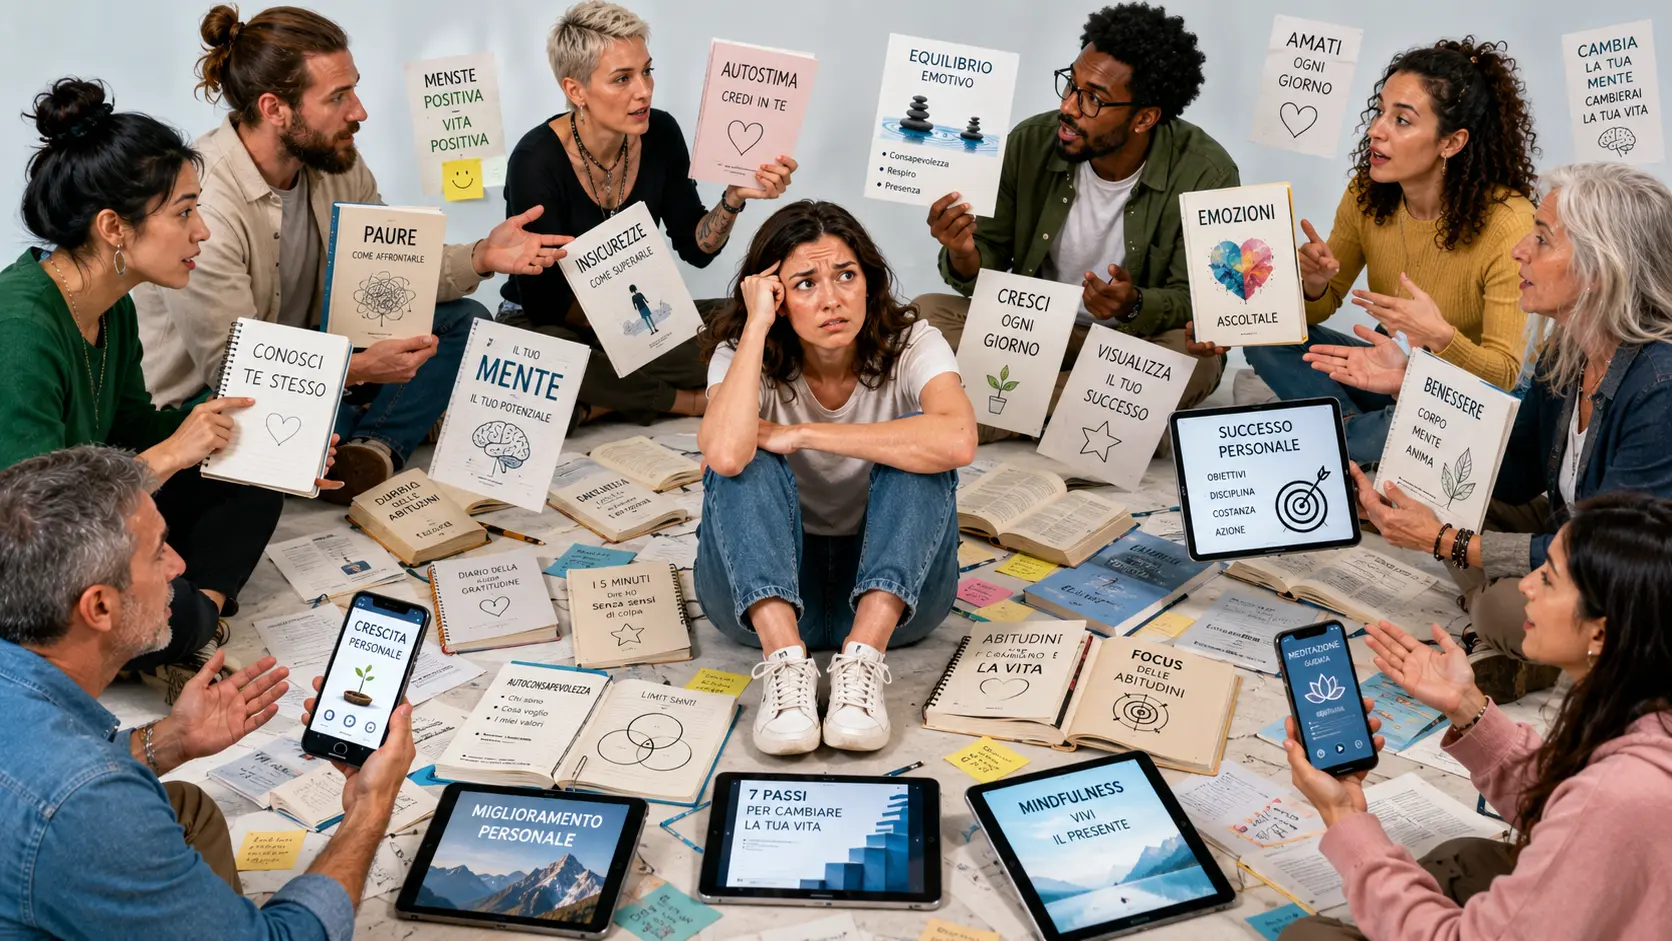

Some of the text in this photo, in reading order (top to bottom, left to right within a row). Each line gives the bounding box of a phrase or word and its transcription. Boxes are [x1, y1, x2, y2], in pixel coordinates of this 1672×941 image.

[1286, 32, 1342, 56] AMATI
[1578, 36, 1639, 58] CAMBIA
[909, 49, 993, 75] EQUILIBRIO
[1294, 57, 1326, 73] OGNI
[1586, 56, 1632, 73] LA TUA
[424, 68, 476, 88] MENSTE
[721, 61, 799, 89] AUTOSTIMA
[921, 71, 974, 88] EMOTIVO
[1278, 74, 1332, 95] GIORNO
[1587, 72, 1634, 89] MENTE
[424, 88, 484, 109] POSITIVA
[721, 90, 787, 111] CREDI IN TE
[1585, 89, 1642, 107] CAMBIERAI
[443, 116, 472, 131] VITA
[1583, 104, 1648, 124] LA TUA VITA
[431, 132, 489, 153] POSITIVA
[889, 151, 950, 168] Consapevolezza
[887, 166, 917, 179] Respiro
[885, 181, 921, 195] Presenza
[1198, 204, 1276, 226] EMOZIONI
[364, 225, 418, 246] PAURE
[352, 250, 425, 264] COME AFFRONTARLE
[575, 222, 647, 273] INSICUREZZE
[590, 245, 654, 289] COME SUPERARLE
[997, 288, 1051, 312] CRESCI
[1001, 314, 1034, 332] OGNI
[1217, 311, 1278, 327] ASCOLTALE
[513, 345, 541, 360] IL TUO
[984, 333, 1040, 357] GIORNO
[253, 342, 324, 369] CONOSCI
[1098, 344, 1172, 381] VISUALIZZA
[244, 368, 327, 397] TE STESSO
[476, 355, 564, 400] MENTE
[1106, 373, 1143, 394] IL TUO
[1084, 388, 1149, 421] SUCCESSO
[1424, 376, 1485, 420] BENESSERE
[470, 394, 552, 423] IL TUO POTENZIALE
[1418, 407, 1447, 429] CORPO
[1219, 420, 1293, 439] SUCCESSO
[1412, 425, 1442, 448] MENTE
[1219, 438, 1300, 458] PERSONALE
[1405, 445, 1434, 468] ANIMA
[1207, 470, 1246, 482] OBIETTIVI
[1210, 487, 1255, 500] DISCIPLINA
[1212, 505, 1256, 518] COSTANZA
[1215, 525, 1245, 536] AZIONE
[458, 564, 518, 579] DIARIO DELLA
[611, 575, 650, 587] MINUTI
[462, 578, 520, 594] GRATITUDINE
[593, 597, 655, 611] Senza sensi
[618, 609, 643, 618] colpa
[354, 620, 407, 644] CRESCITA
[348, 637, 402, 660] PERSONALE
[1288, 640, 1340, 660] MEDITAZIONE
[977, 663, 1042, 674] LA VITA
[1131, 649, 1183, 670] FOCUS
[1136, 665, 1170, 680] DELLE
[507, 678, 591, 695] AUTOCONSAPEVOLEZZA
[1114, 672, 1186, 699] ABITUDINI
[508, 695, 521, 703] Chi
[641, 691, 668, 702] LIMIT
[501, 705, 549, 717] Cosa voglio
[500, 717, 517, 725] miei
[519, 719, 544, 728] valori
[749, 789, 807, 802] 7 PASSI
[1018, 780, 1124, 816] MINDFULNESS
[471, 804, 603, 829] MIGLIORAMENTO
[747, 805, 843, 818] PER CAMBIARE
[1070, 809, 1096, 824] VIVI
[477, 825, 576, 847] PERSONALE
[745, 819, 821, 833] LA TUA VITA
[1053, 818, 1131, 846] IL PRESENTE
